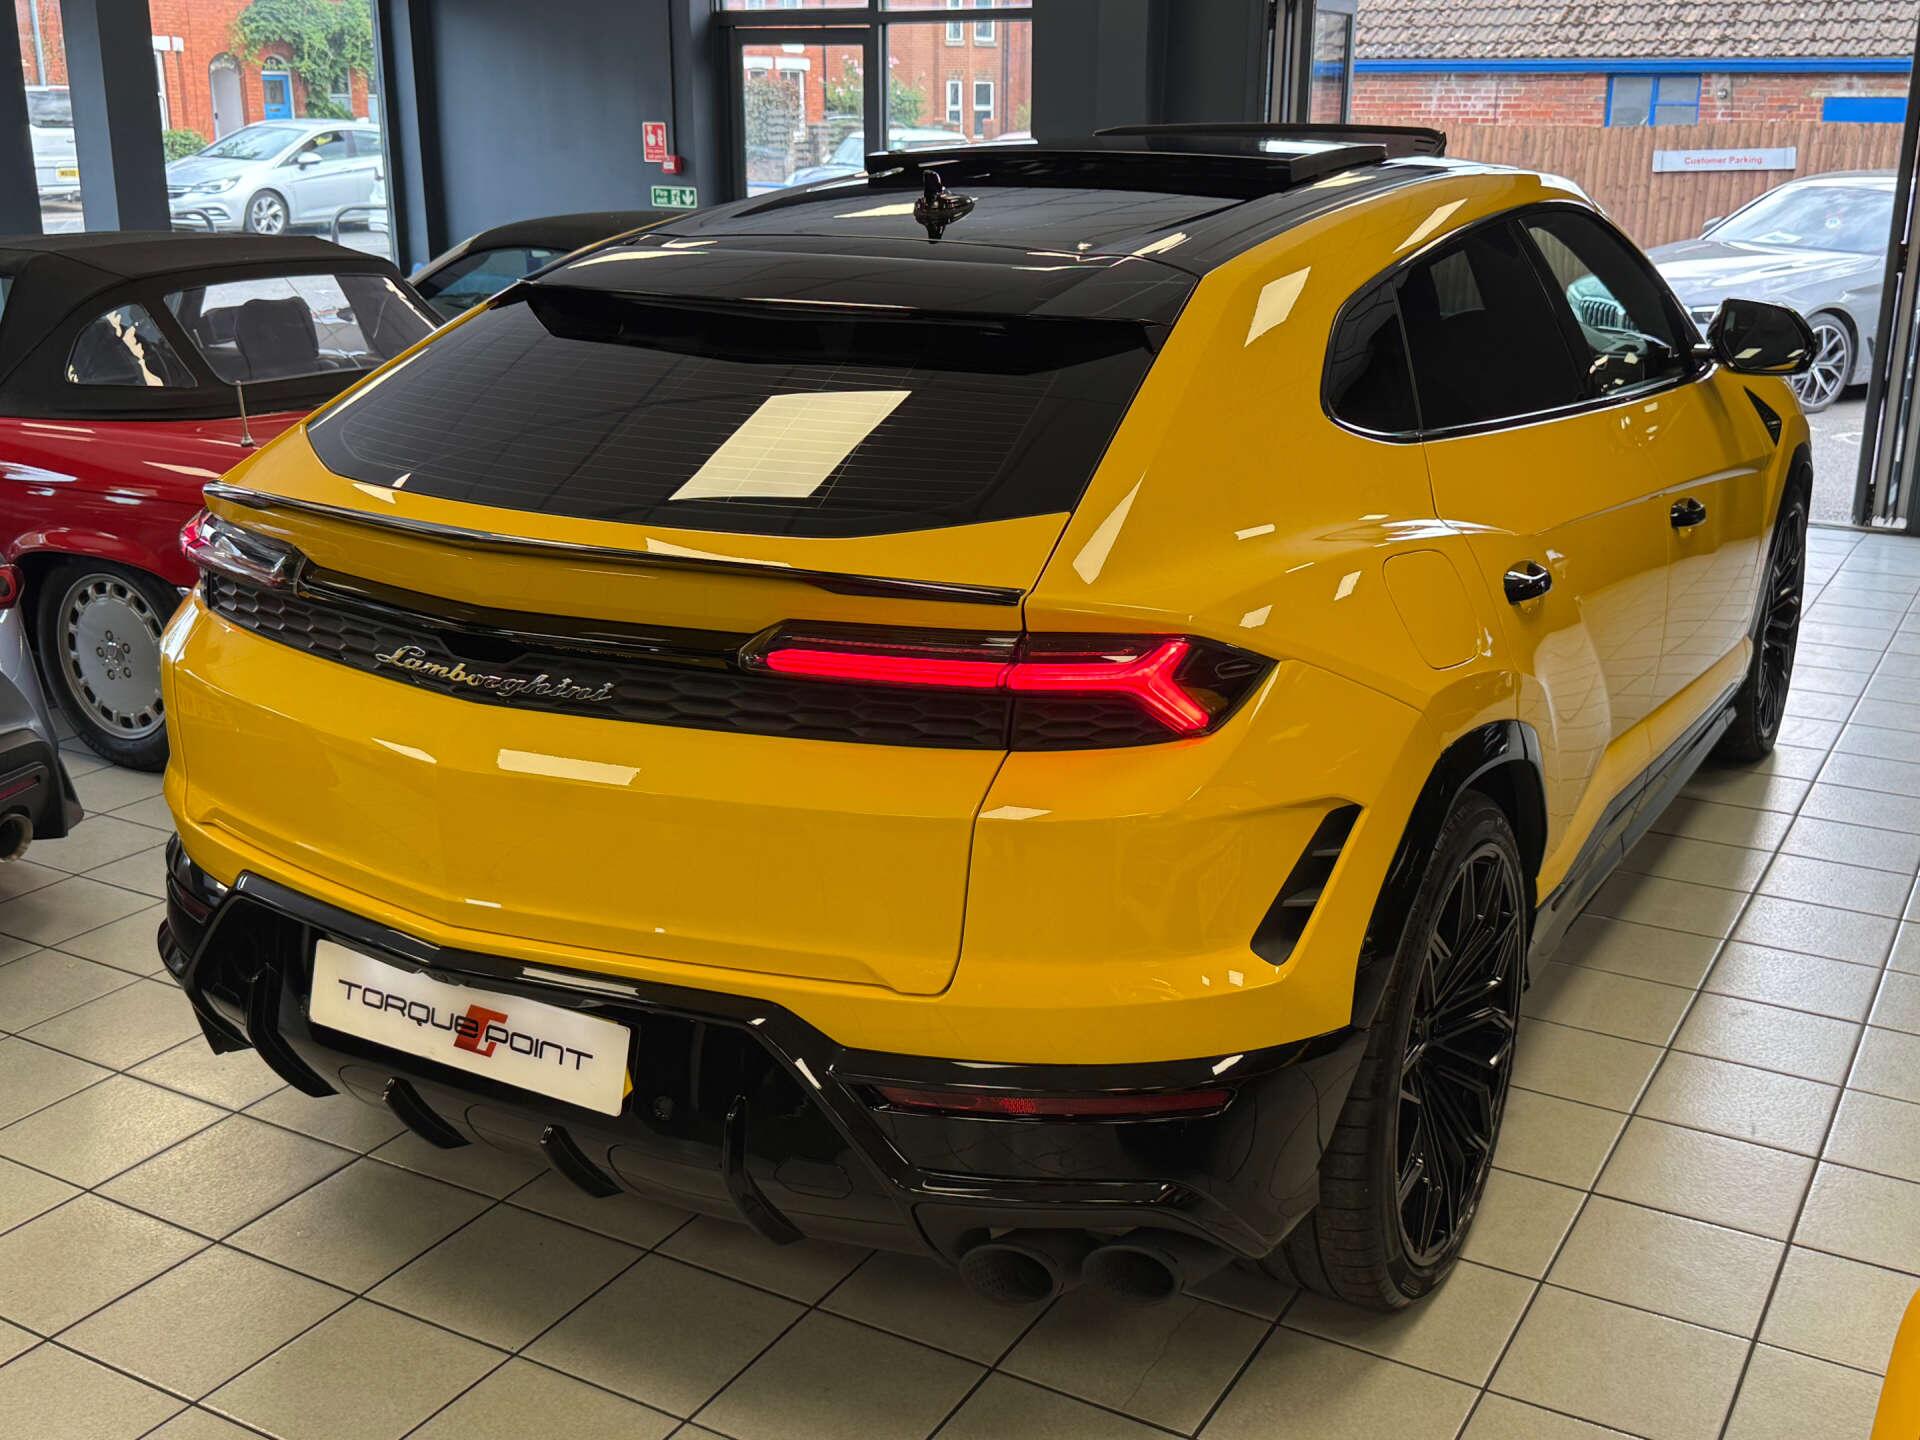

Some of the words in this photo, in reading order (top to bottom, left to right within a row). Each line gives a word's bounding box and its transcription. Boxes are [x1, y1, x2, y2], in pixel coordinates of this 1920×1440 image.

[1684, 157, 1726, 165] Customer
[1728, 156, 1763, 166] Parking
[375, 645, 614, 701] Lamborghini
